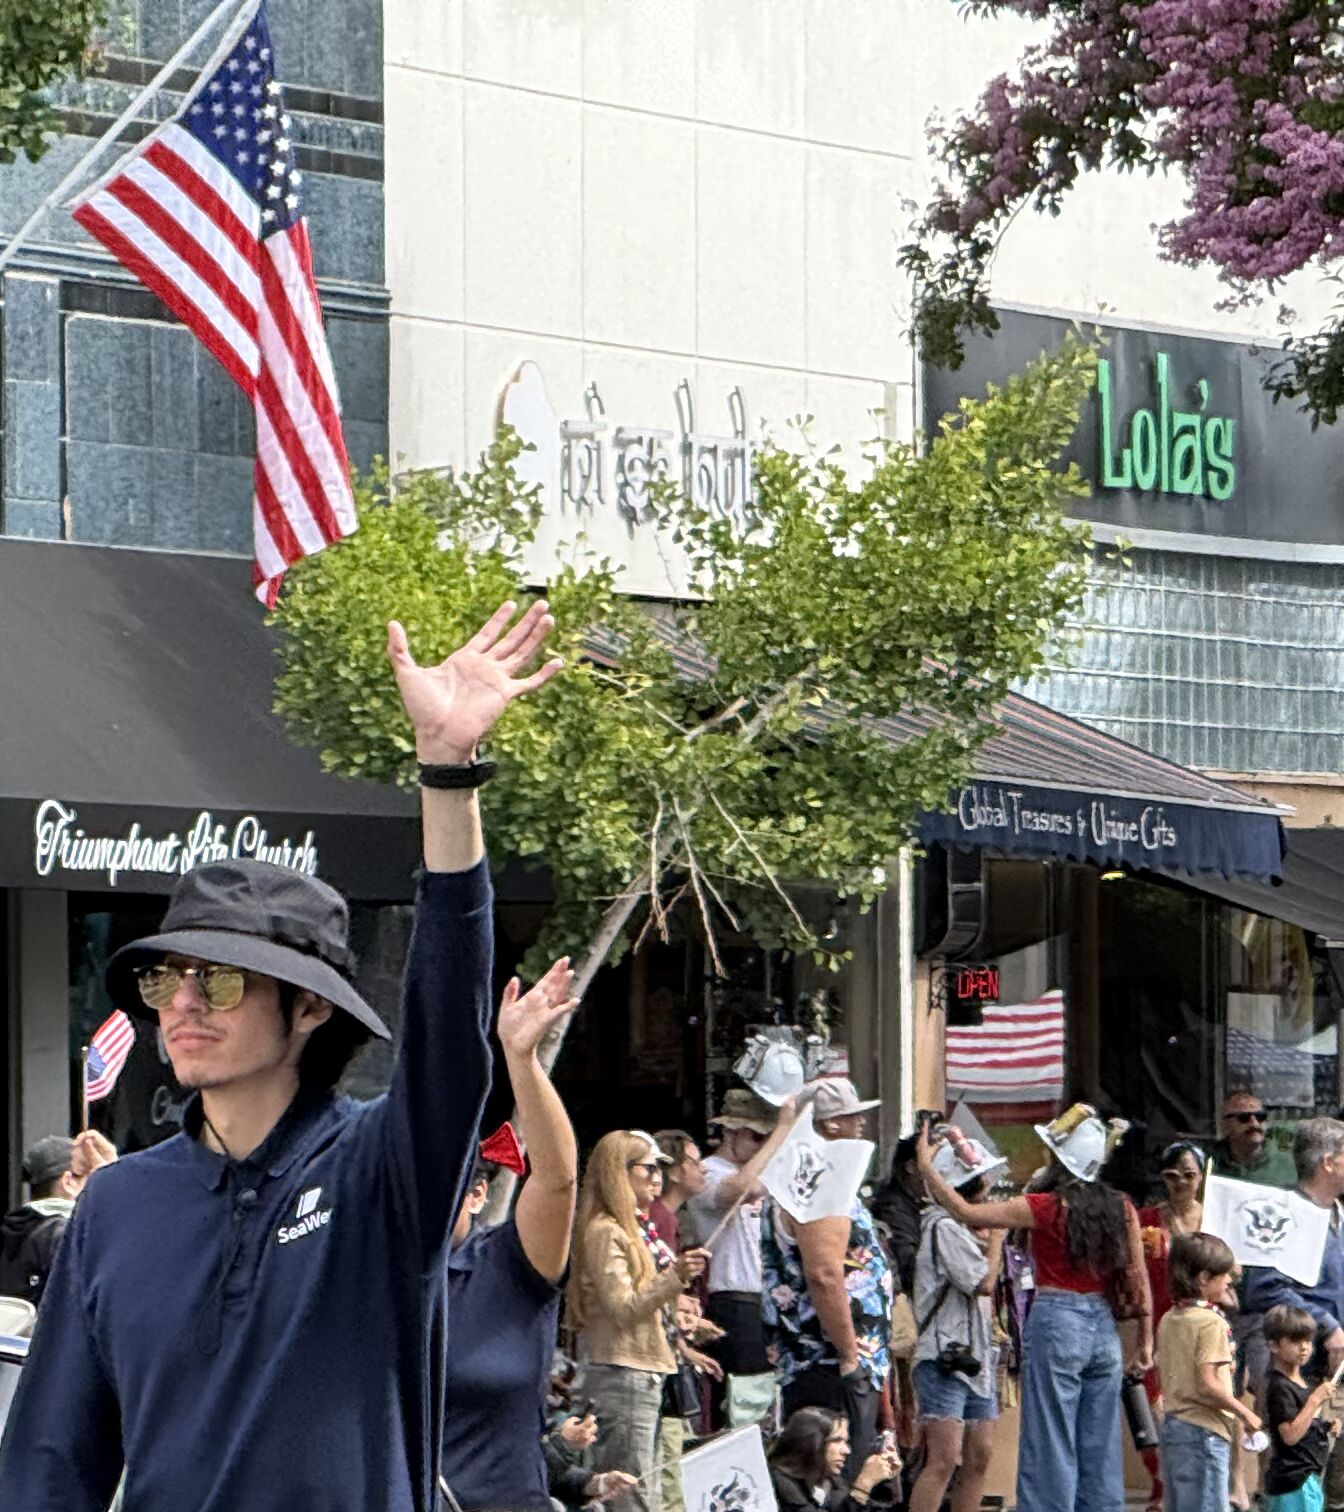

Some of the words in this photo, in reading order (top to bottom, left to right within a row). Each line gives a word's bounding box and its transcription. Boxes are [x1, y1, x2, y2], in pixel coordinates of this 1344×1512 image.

[1098, 352, 1236, 500] Lola's
[35, 799, 182, 887] Triumphant
[231, 815, 319, 876] Church
[958, 787, 1008, 831] Global
[1090, 800, 1140, 856] Unique
[1140, 806, 1177, 850] Gifts
[957, 968, 999, 1000] OPEN
